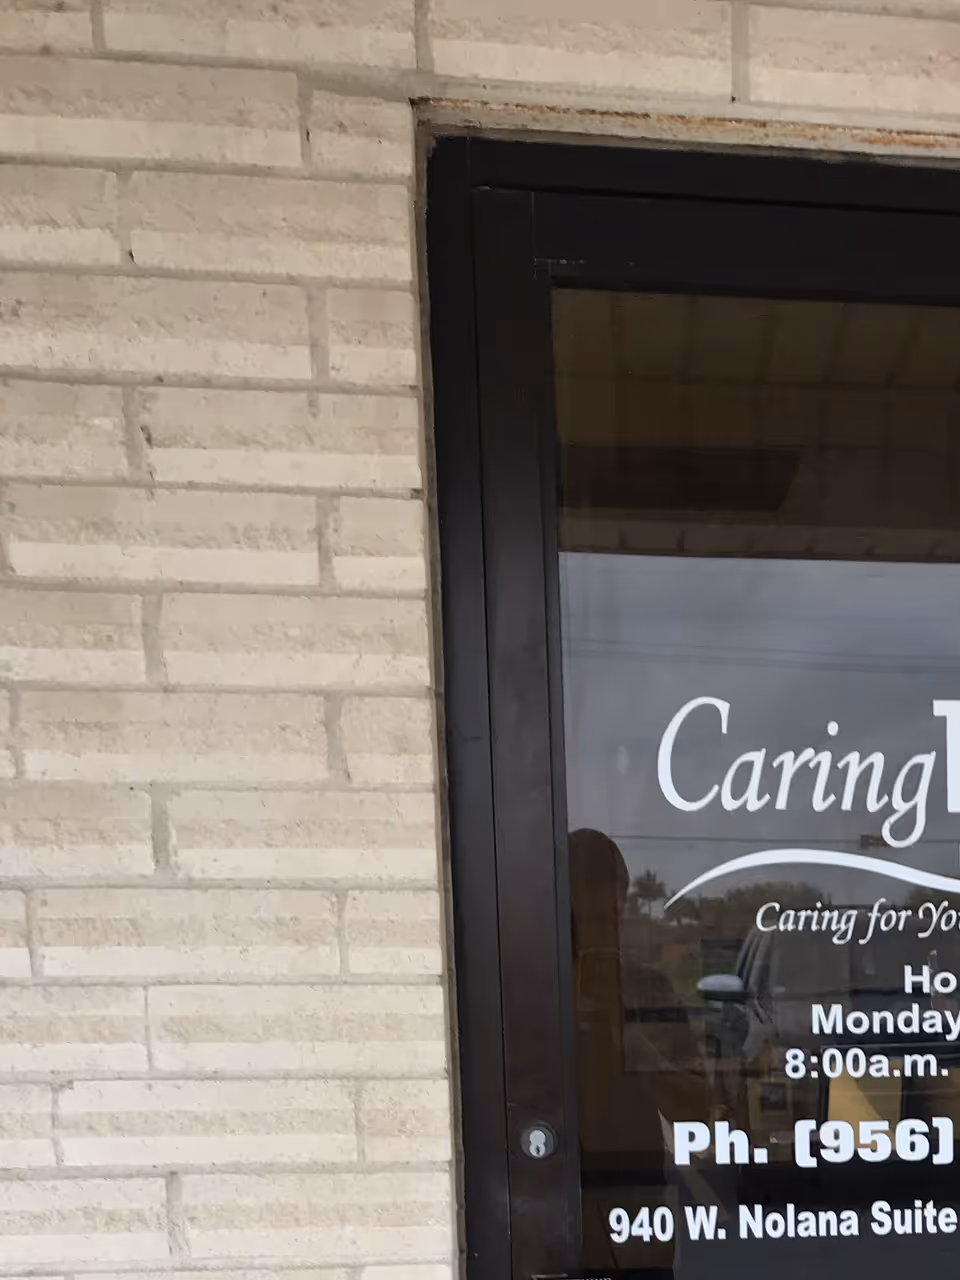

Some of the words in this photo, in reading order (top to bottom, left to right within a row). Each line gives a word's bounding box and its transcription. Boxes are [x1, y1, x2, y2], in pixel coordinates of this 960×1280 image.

[657, 695, 936, 848] Caring
[756, 901, 858, 945] Caring
[858, 897, 912, 945] for
[785, 1047, 949, 1079] 8:00a.m.
[673, 1120, 769, 1166] Ph.
[794, 1116, 955, 1168] (956)
[608, 1206, 674, 1243] 940
[684, 1205, 728, 1241] W.
[738, 1203, 860, 1239] Nolana
[870, 1199, 958, 1236] Suite
